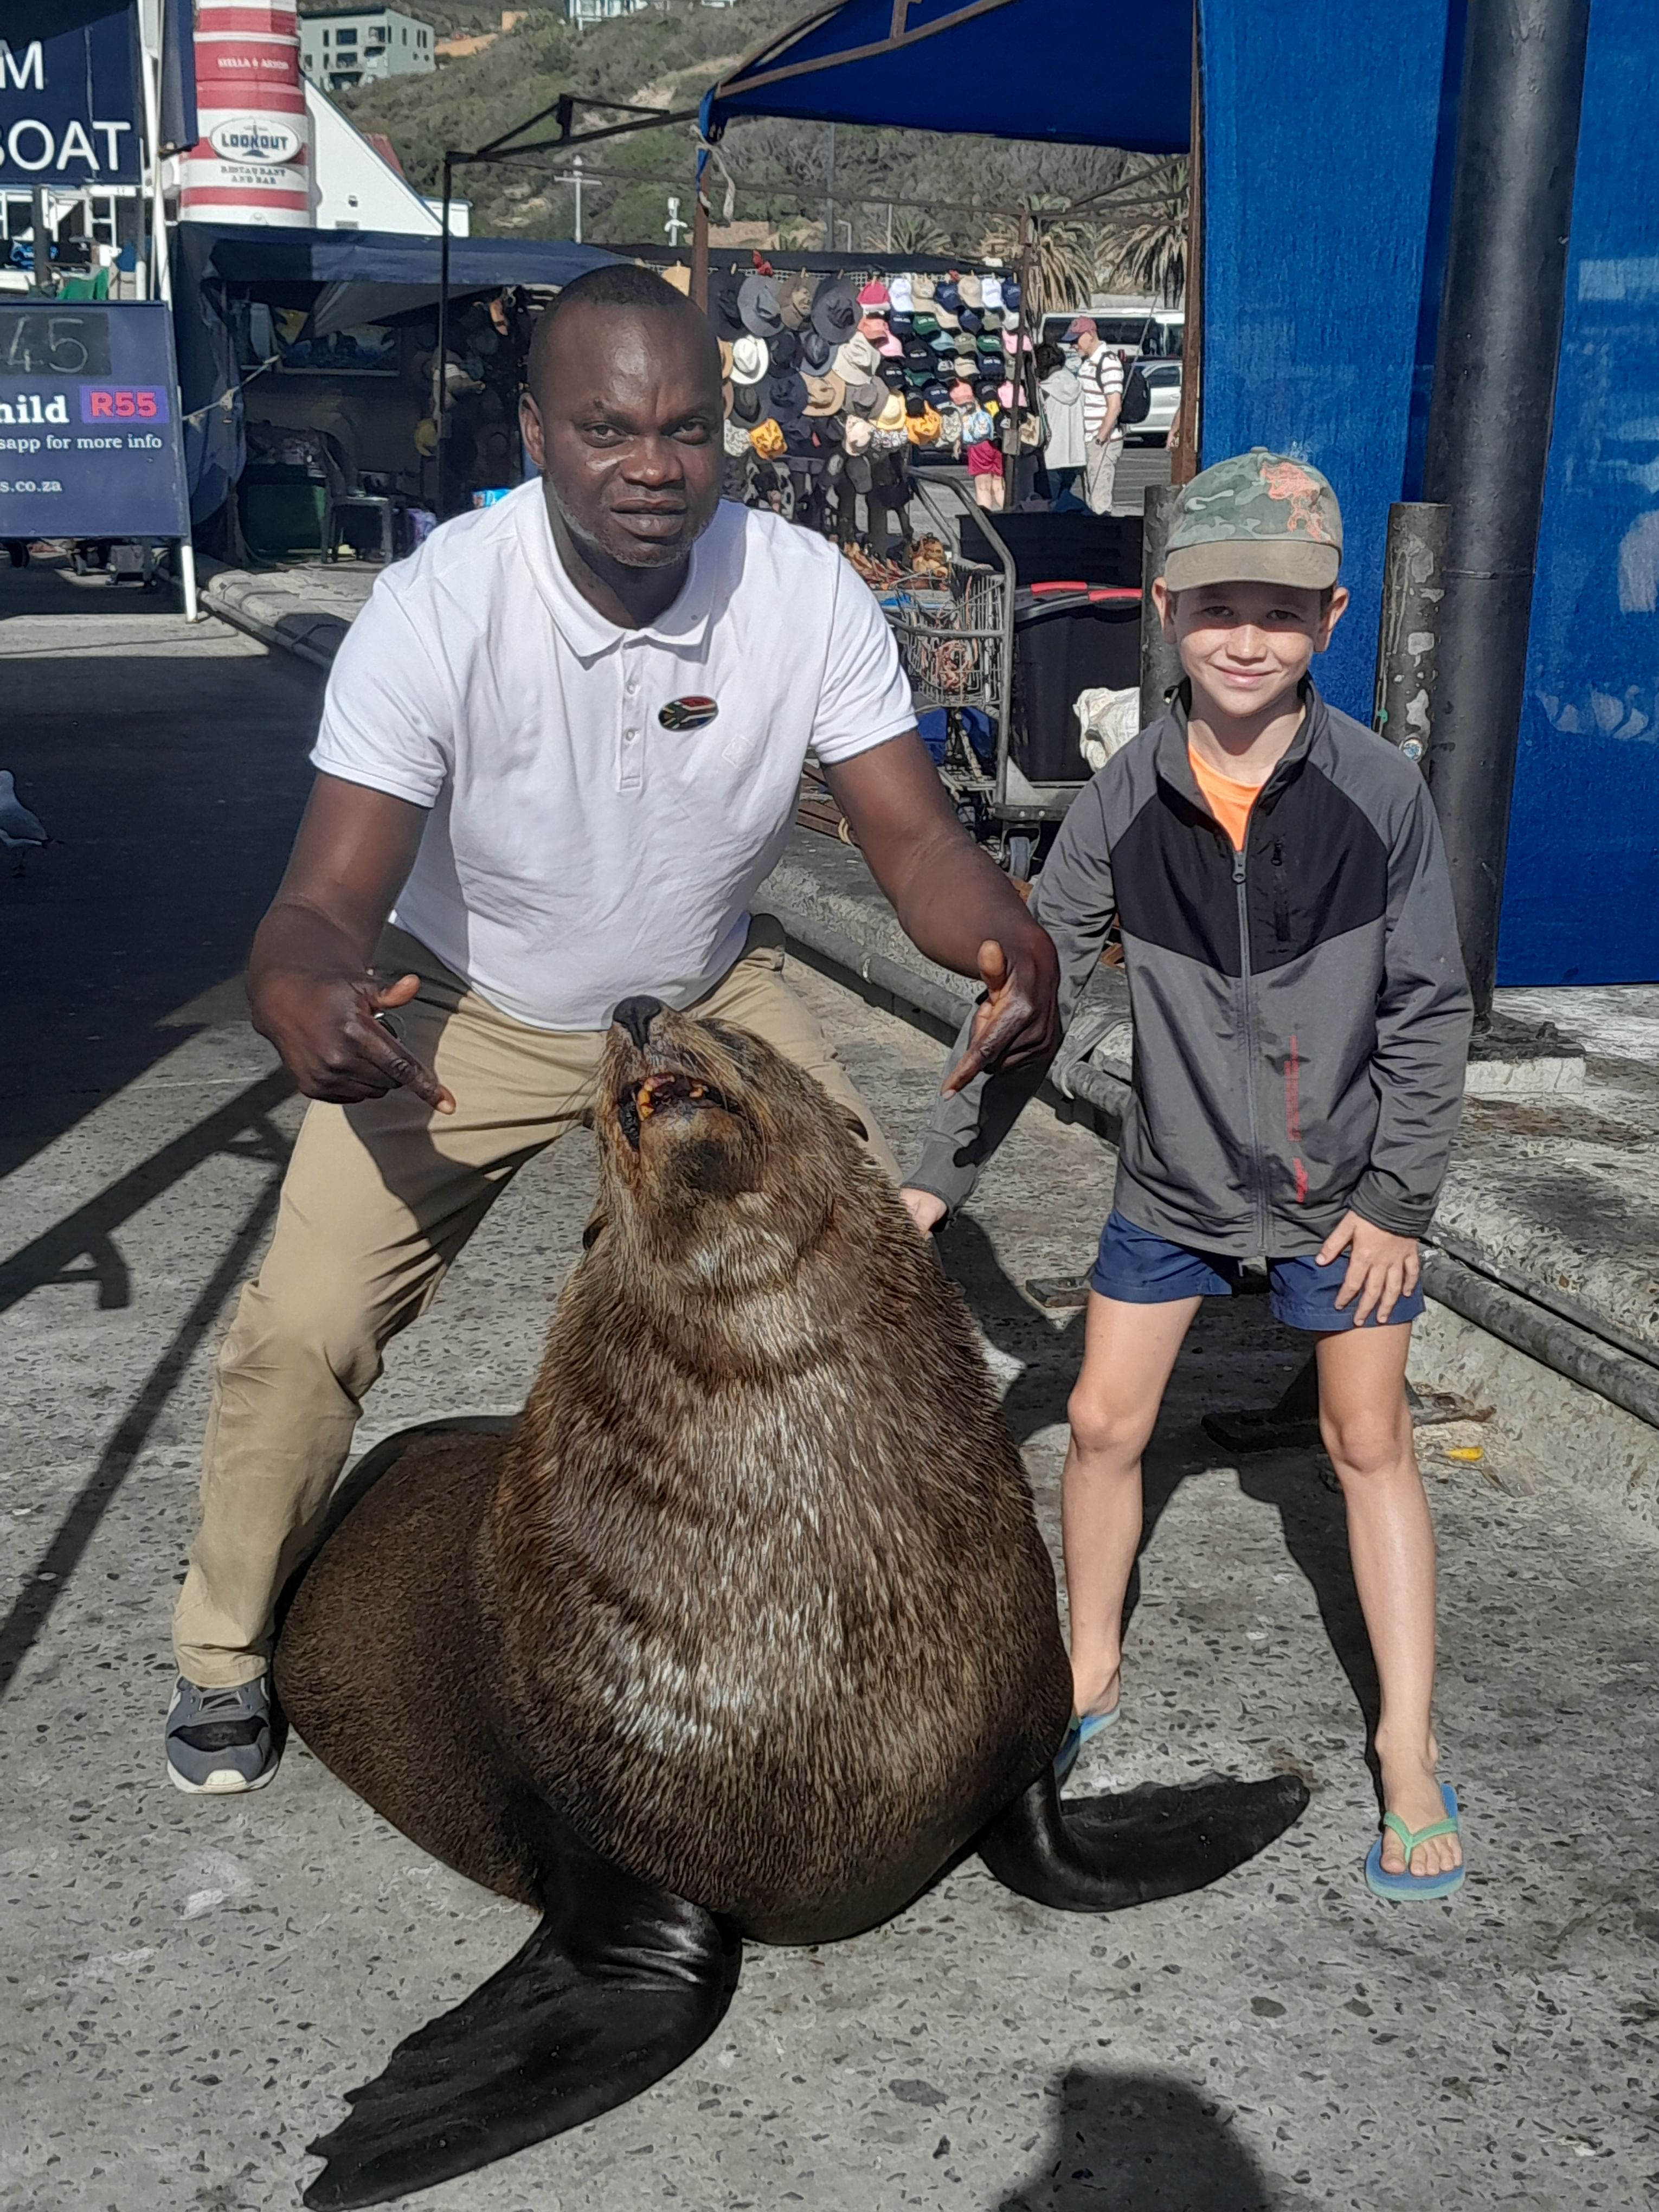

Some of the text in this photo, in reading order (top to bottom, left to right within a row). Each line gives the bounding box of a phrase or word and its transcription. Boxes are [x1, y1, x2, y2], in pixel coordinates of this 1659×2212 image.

[0, 119, 131, 170] OAT
[221, 133, 288, 150] LOOKOUT
[221, 165, 286, 177] RESTAURANT
[7, 313, 88, 373] 45
[90, 391, 158, 417] R55
[46, 434, 72, 449] for
[77, 438, 123, 449] more
[127, 434, 162, 449] info
